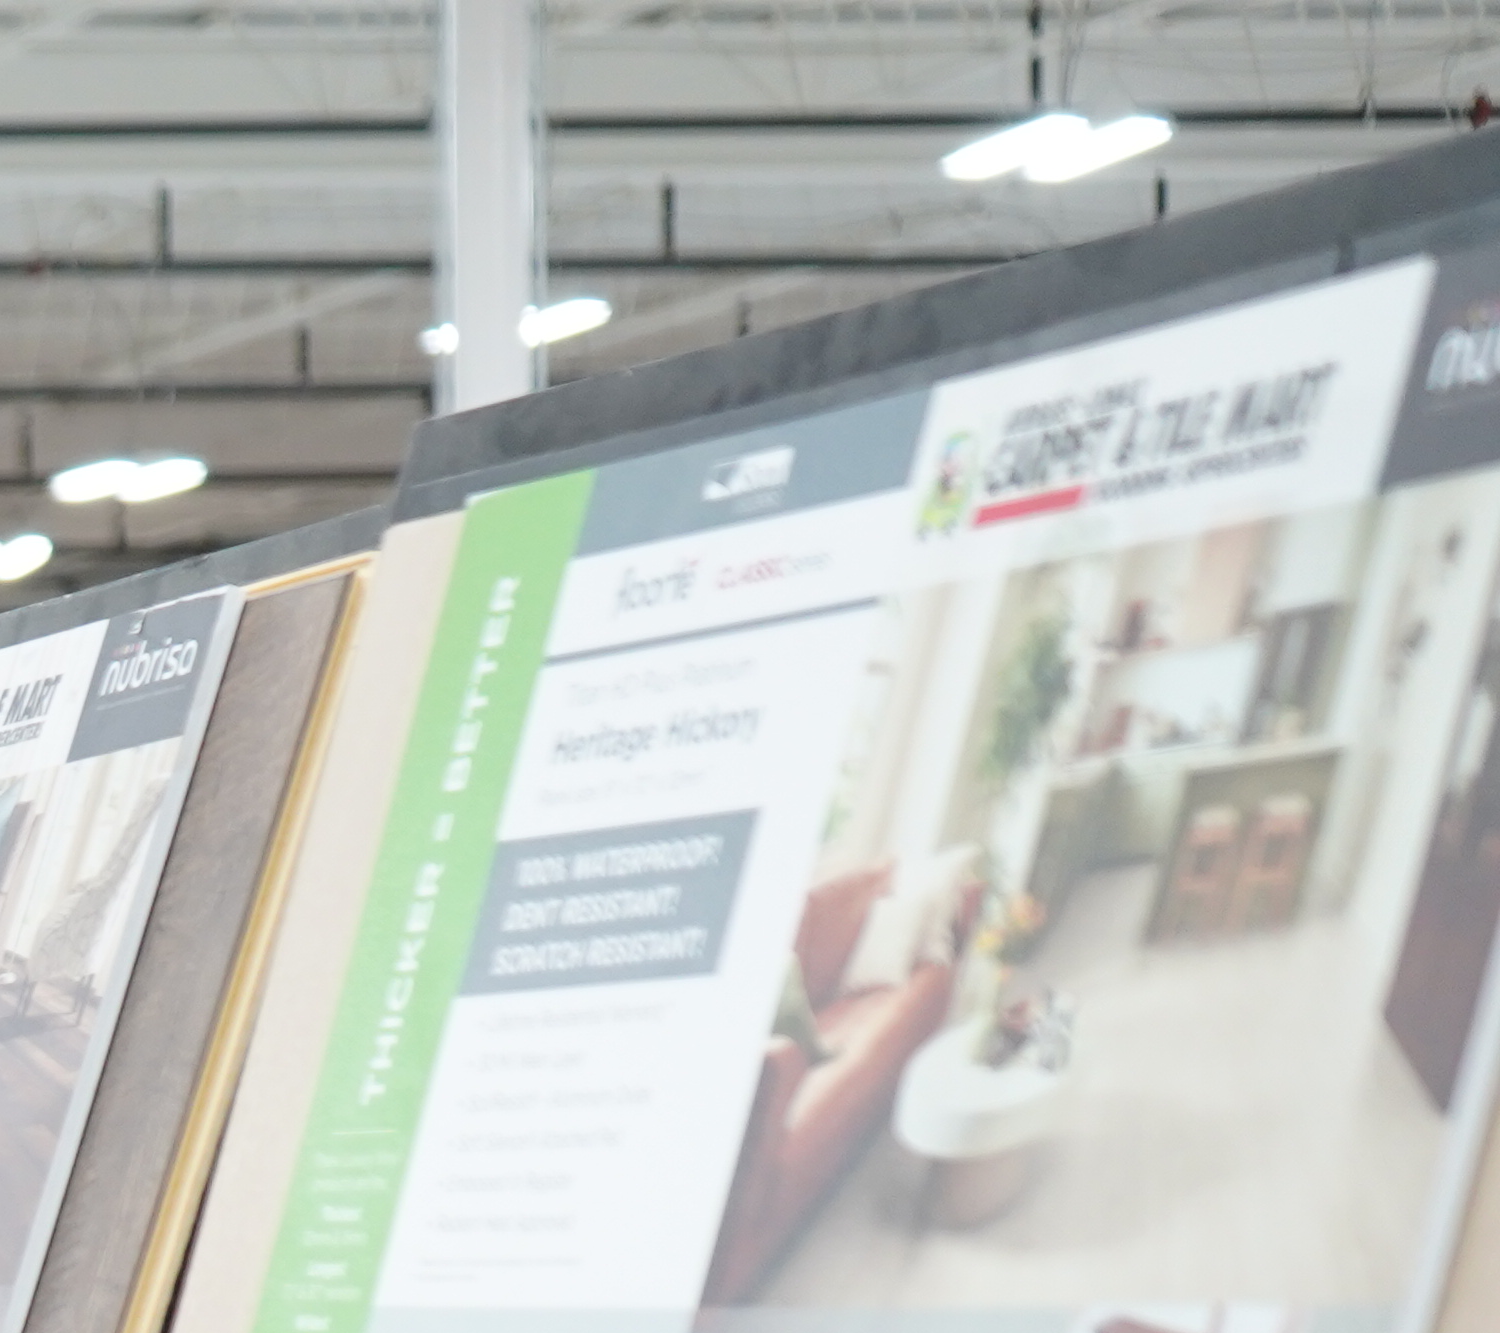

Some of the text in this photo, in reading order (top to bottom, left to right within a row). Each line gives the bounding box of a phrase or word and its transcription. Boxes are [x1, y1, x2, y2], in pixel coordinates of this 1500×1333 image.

[2, 673, 65, 727] MART
[359, 860, 446, 1108] THICKER
[441, 574, 521, 794] BETTER
[571, 832, 725, 881] WATERPROOF!
[501, 884, 682, 932] DENT RESISTANT!
[489, 925, 708, 976] SCRATCH RESISTANT!
